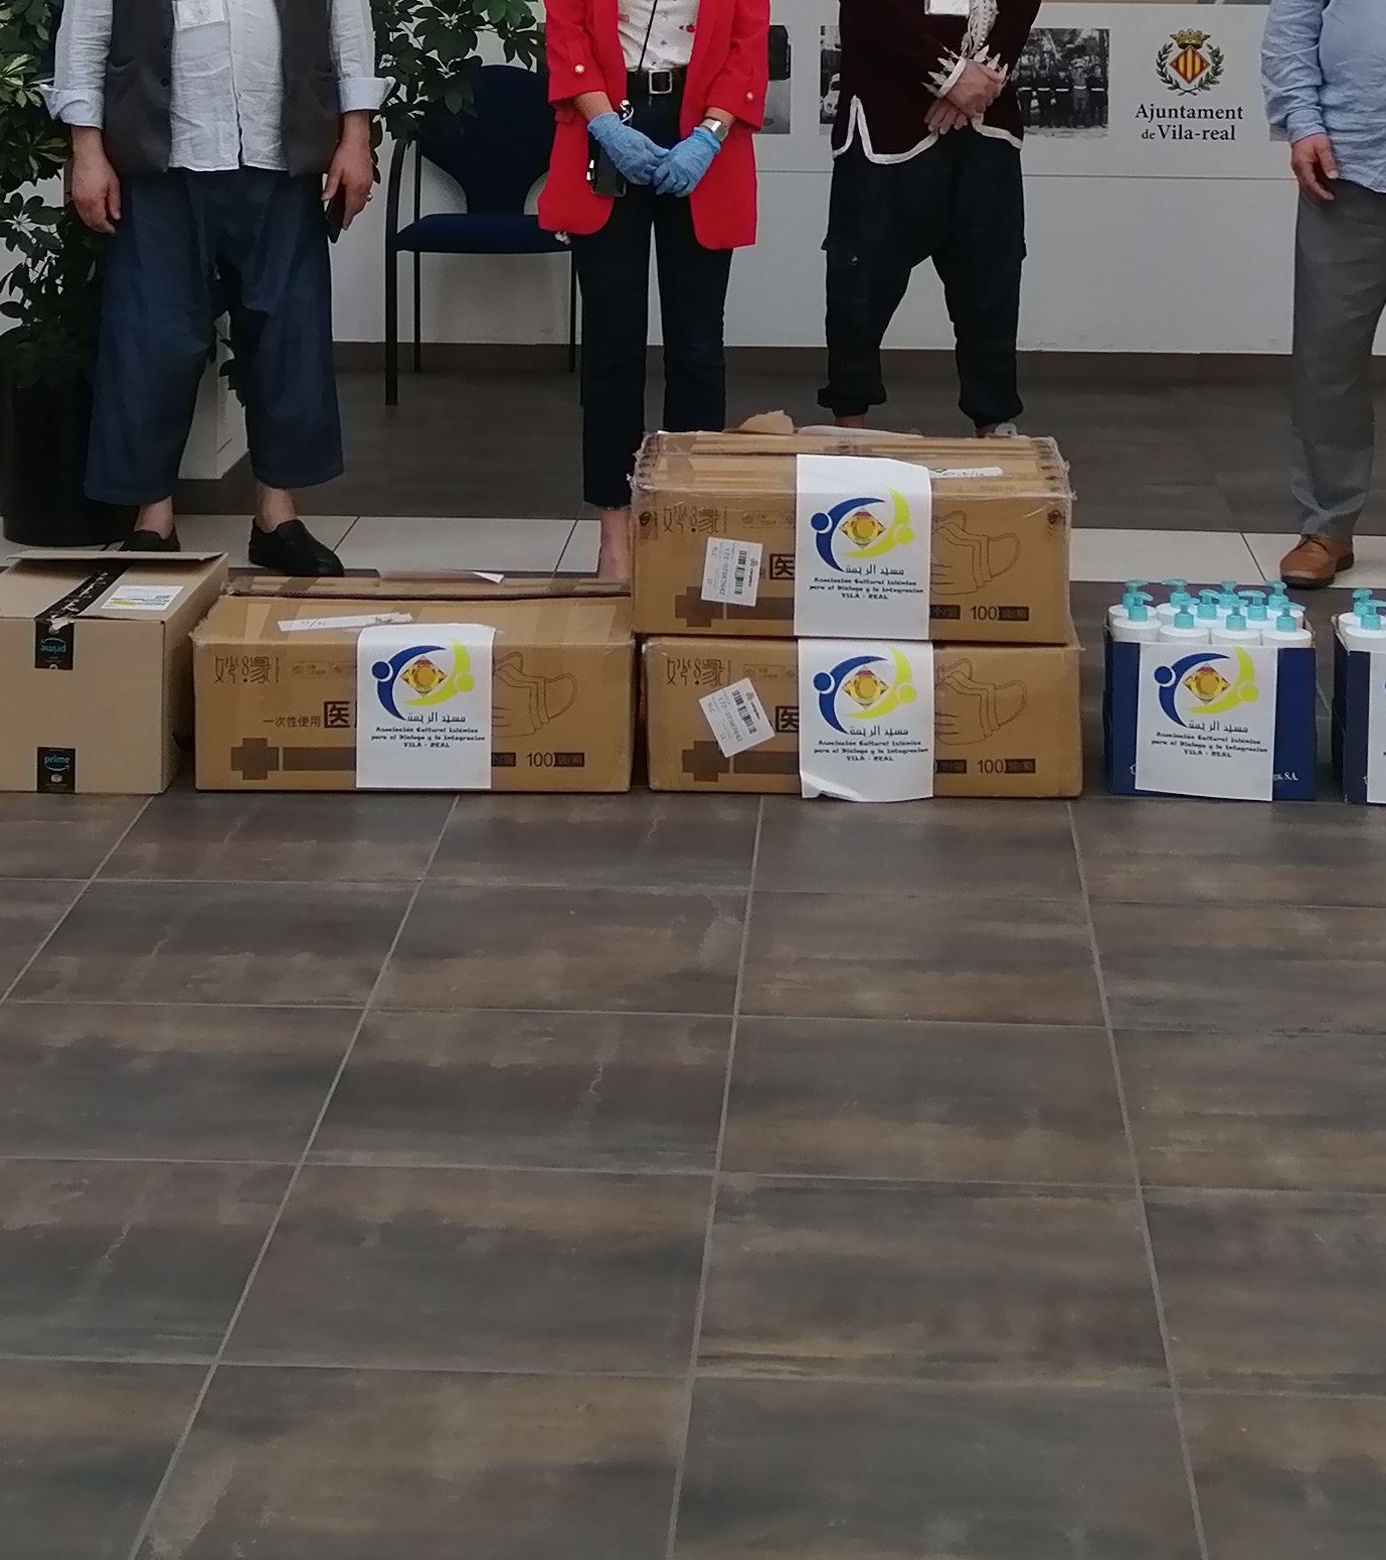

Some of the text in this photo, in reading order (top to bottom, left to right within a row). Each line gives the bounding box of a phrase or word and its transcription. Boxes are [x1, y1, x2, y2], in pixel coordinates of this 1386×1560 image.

[1135, 103, 1243, 124] Ajuntament
[1141, 124, 1236, 140] de Vila-real
[970, 605, 997, 620] 100
[526, 752, 553, 767] 100
[976, 759, 1004, 774] 100
